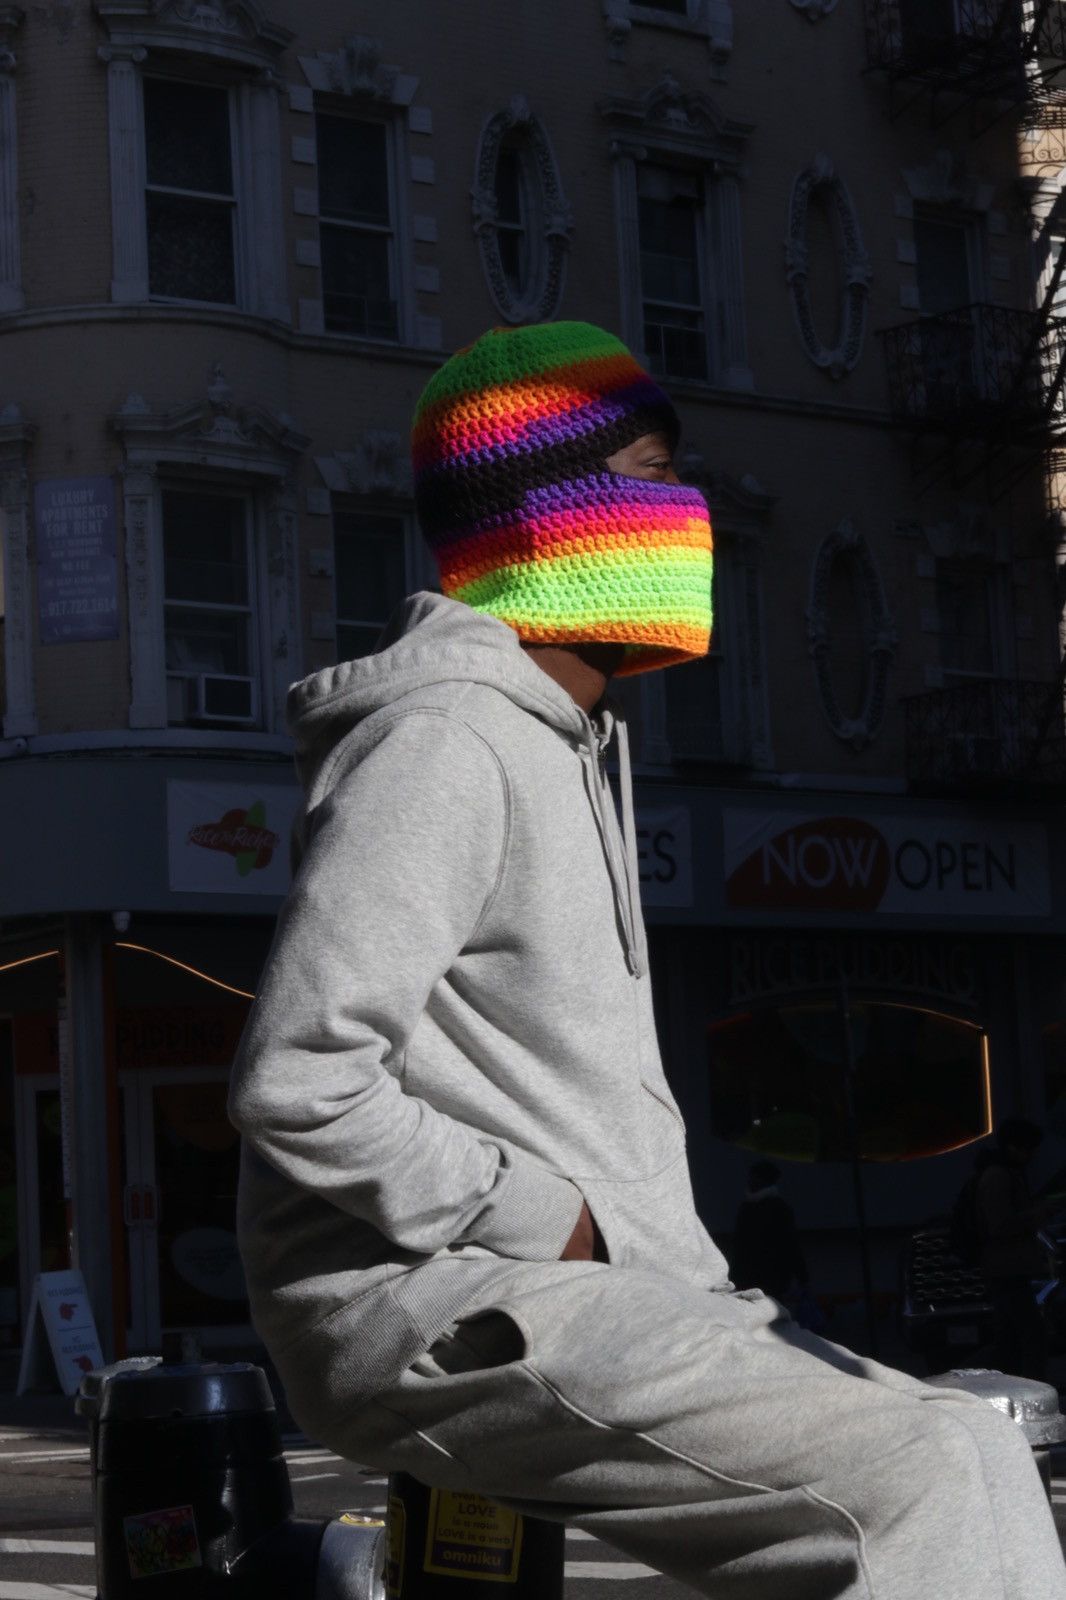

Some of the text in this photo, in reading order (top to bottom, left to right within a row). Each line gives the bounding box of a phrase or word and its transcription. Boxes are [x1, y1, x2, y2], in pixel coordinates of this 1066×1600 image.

[51, 490, 95, 506] LUXURY
[41, 505, 109, 523] APARTMENTS
[46, 520, 103, 538] FOR RENT
[763, 832, 1017, 892] NOW OPEN
[731, 938, 976, 1001] RICE PUDDING
[458, 1503, 497, 1518] LOVE
[439, 1528, 465, 1539] LOVE
[443, 1550, 502, 1567] omniku
